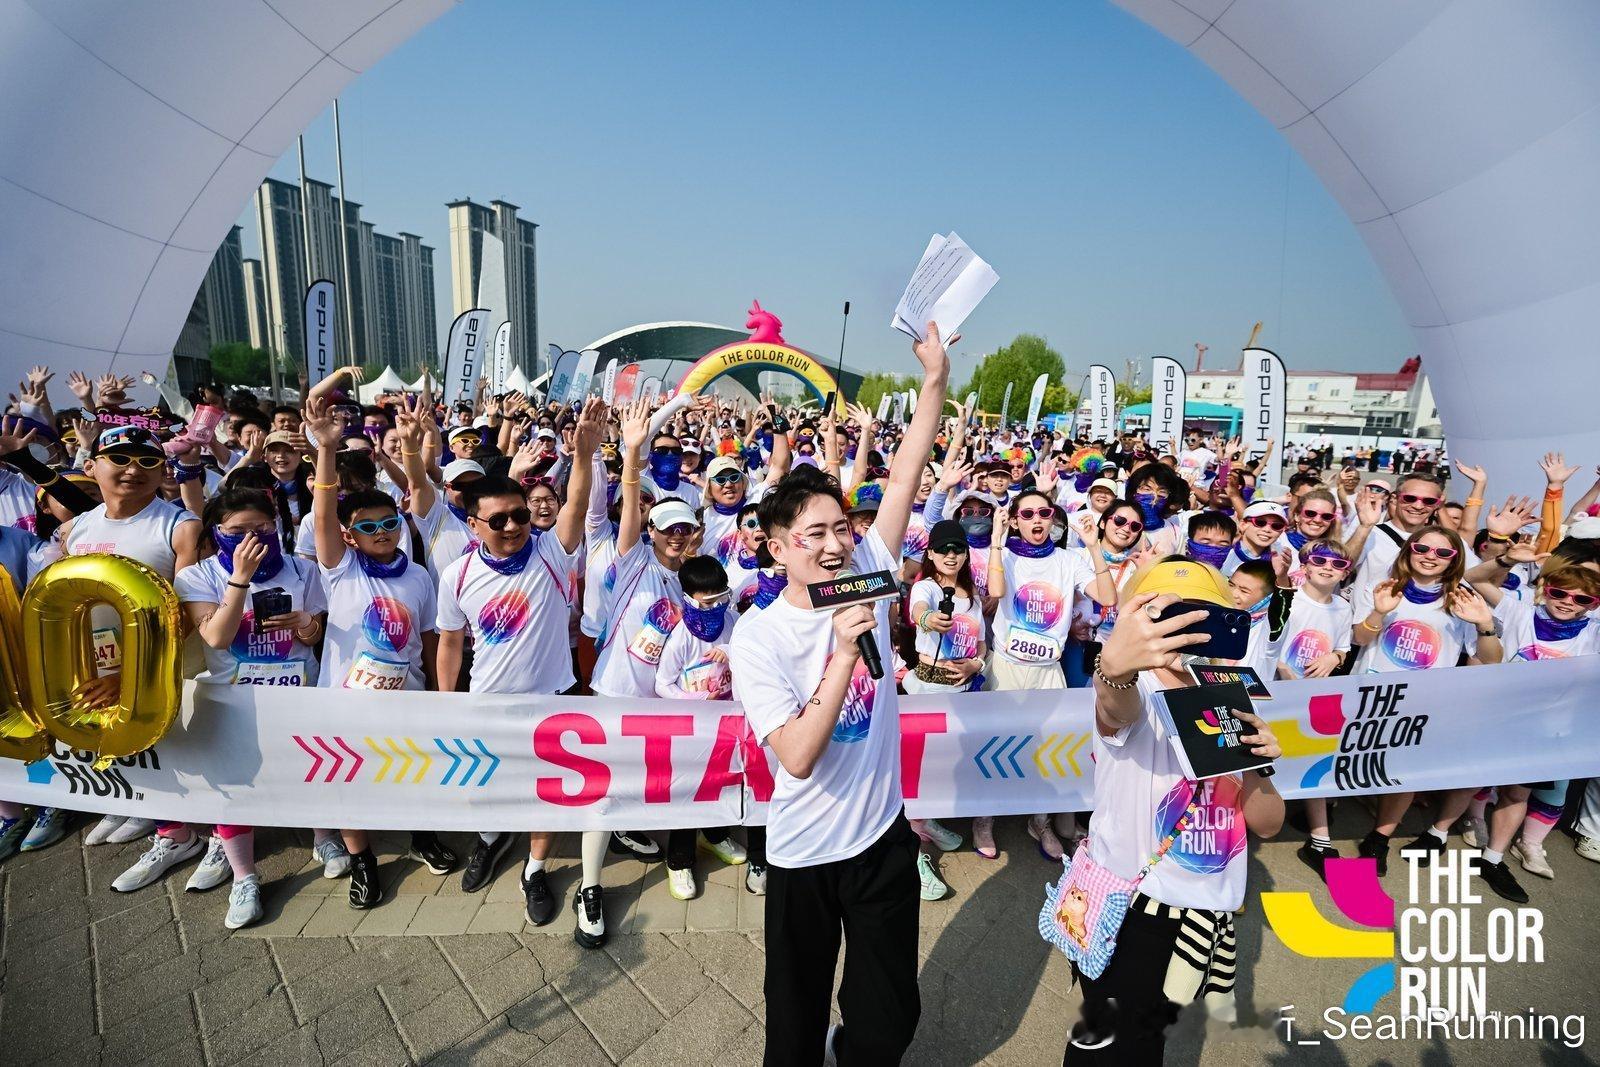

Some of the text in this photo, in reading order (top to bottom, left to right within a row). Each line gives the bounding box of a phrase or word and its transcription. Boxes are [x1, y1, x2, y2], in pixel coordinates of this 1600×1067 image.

[460, 318, 479, 392] Honda
[720, 349, 811, 372] THE COLOR RUN
[1099, 371, 1108, 429] Honda
[1161, 365, 1175, 433] Honda
[1256, 358, 1271, 441] Honda
[817, 585, 835, 597] THE
[835, 579, 867, 594] COLOR
[866, 576, 884, 587] RUN
[1027, 589, 1044, 601] THE
[1026, 600, 1056, 613] COLOR
[955, 621, 970, 635] THE
[1400, 625, 1422, 640] THE
[952, 633, 977, 648] COLOR
[1010, 638, 1054, 659] 28801
[1301, 636, 1320, 648] THE
[1396, 636, 1434, 656] COLOR
[237, 674, 302, 687] 25189
[355, 668, 404, 690] 17332
[1201, 671, 1217, 683] THE
[1355, 683, 1408, 720] THE
[840, 697, 869, 731] RUN
[1213, 705, 1230, 720] THE
[1219, 718, 1243, 734] COLOR
[1340, 714, 1429, 754] COLOR
[533, 712, 947, 807] STAT
[55, 761, 134, 800] RUN
[1334, 750, 1393, 791] RUN
[1180, 830, 1216, 855] RUN
